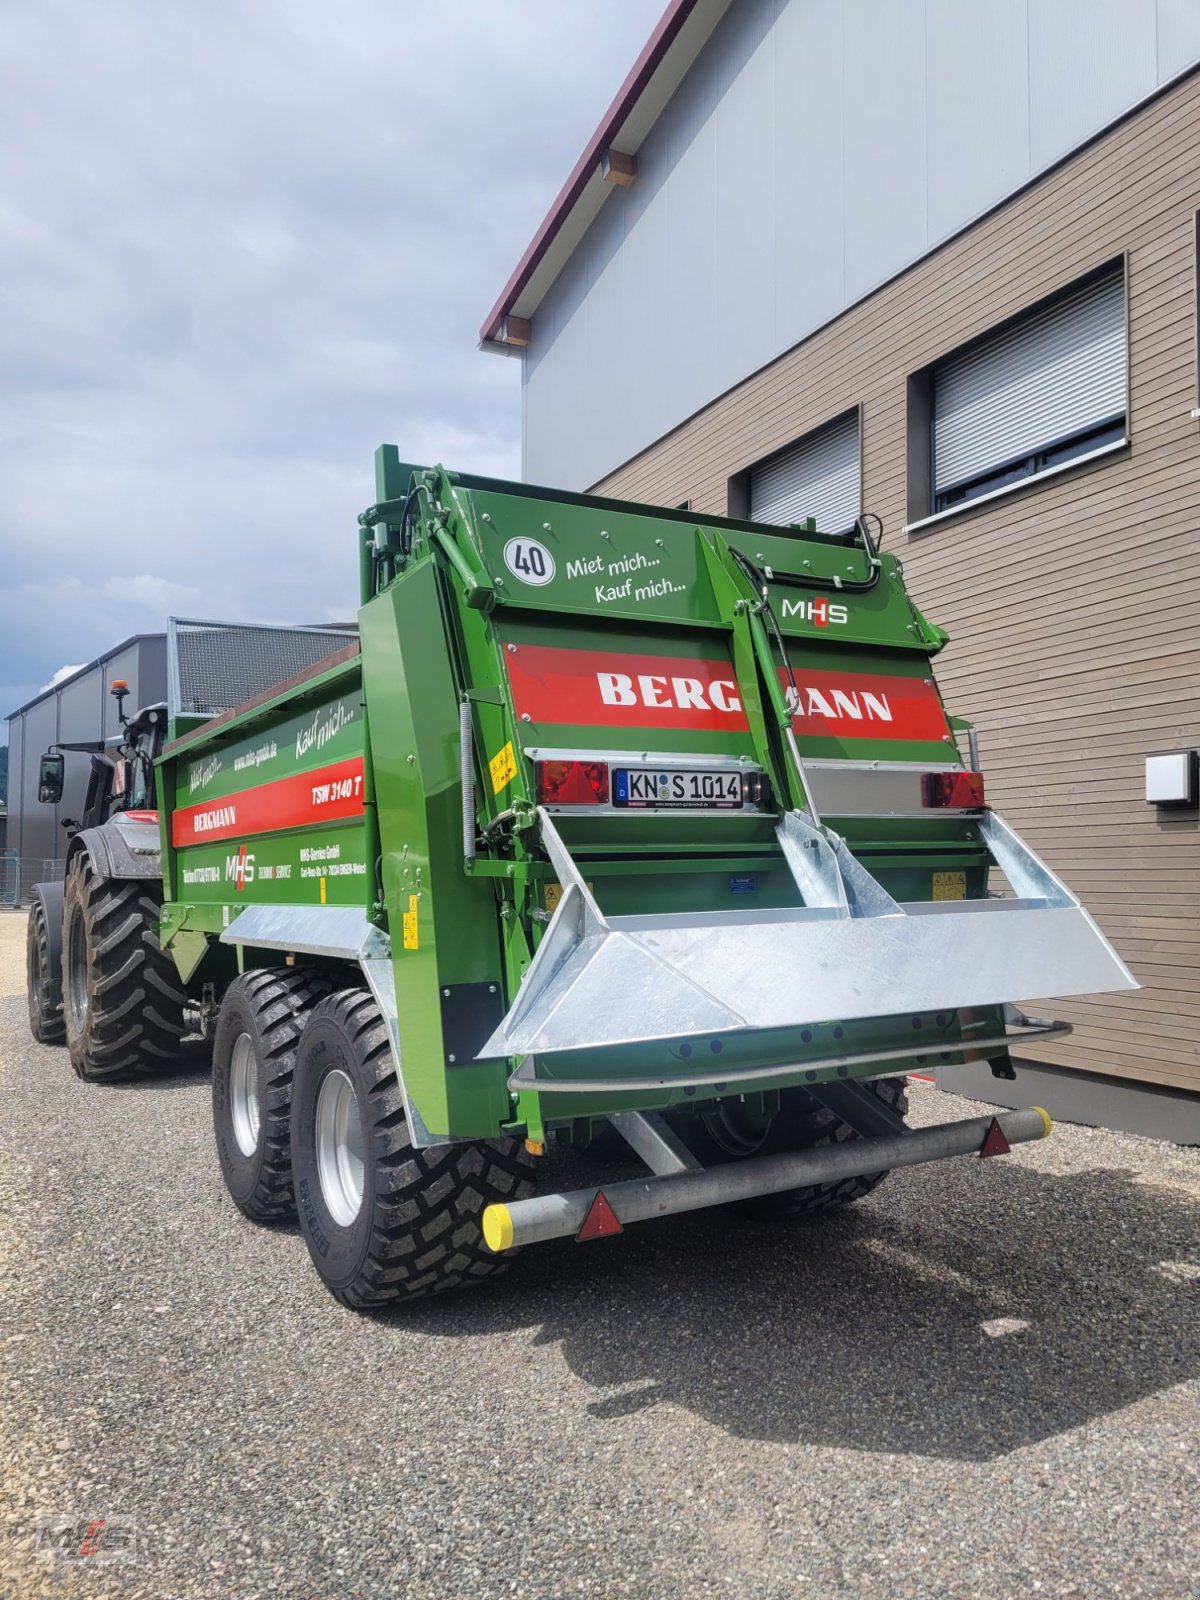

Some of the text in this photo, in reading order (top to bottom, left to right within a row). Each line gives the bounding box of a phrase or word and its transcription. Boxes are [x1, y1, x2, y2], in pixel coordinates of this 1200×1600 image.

[515, 544, 546, 577] 40
[566, 553, 660, 579] Miet mich...
[595, 578, 687, 603] Kauf mich...
[782, 599, 848, 625] MHS
[296, 710, 320, 760] Kauf
[312, 775, 362, 805] TSW 3140 T
[630, 774, 738, 799] KN S 1014
[194, 806, 236, 832] BERGMANN
[225, 854, 255, 882] MHS
